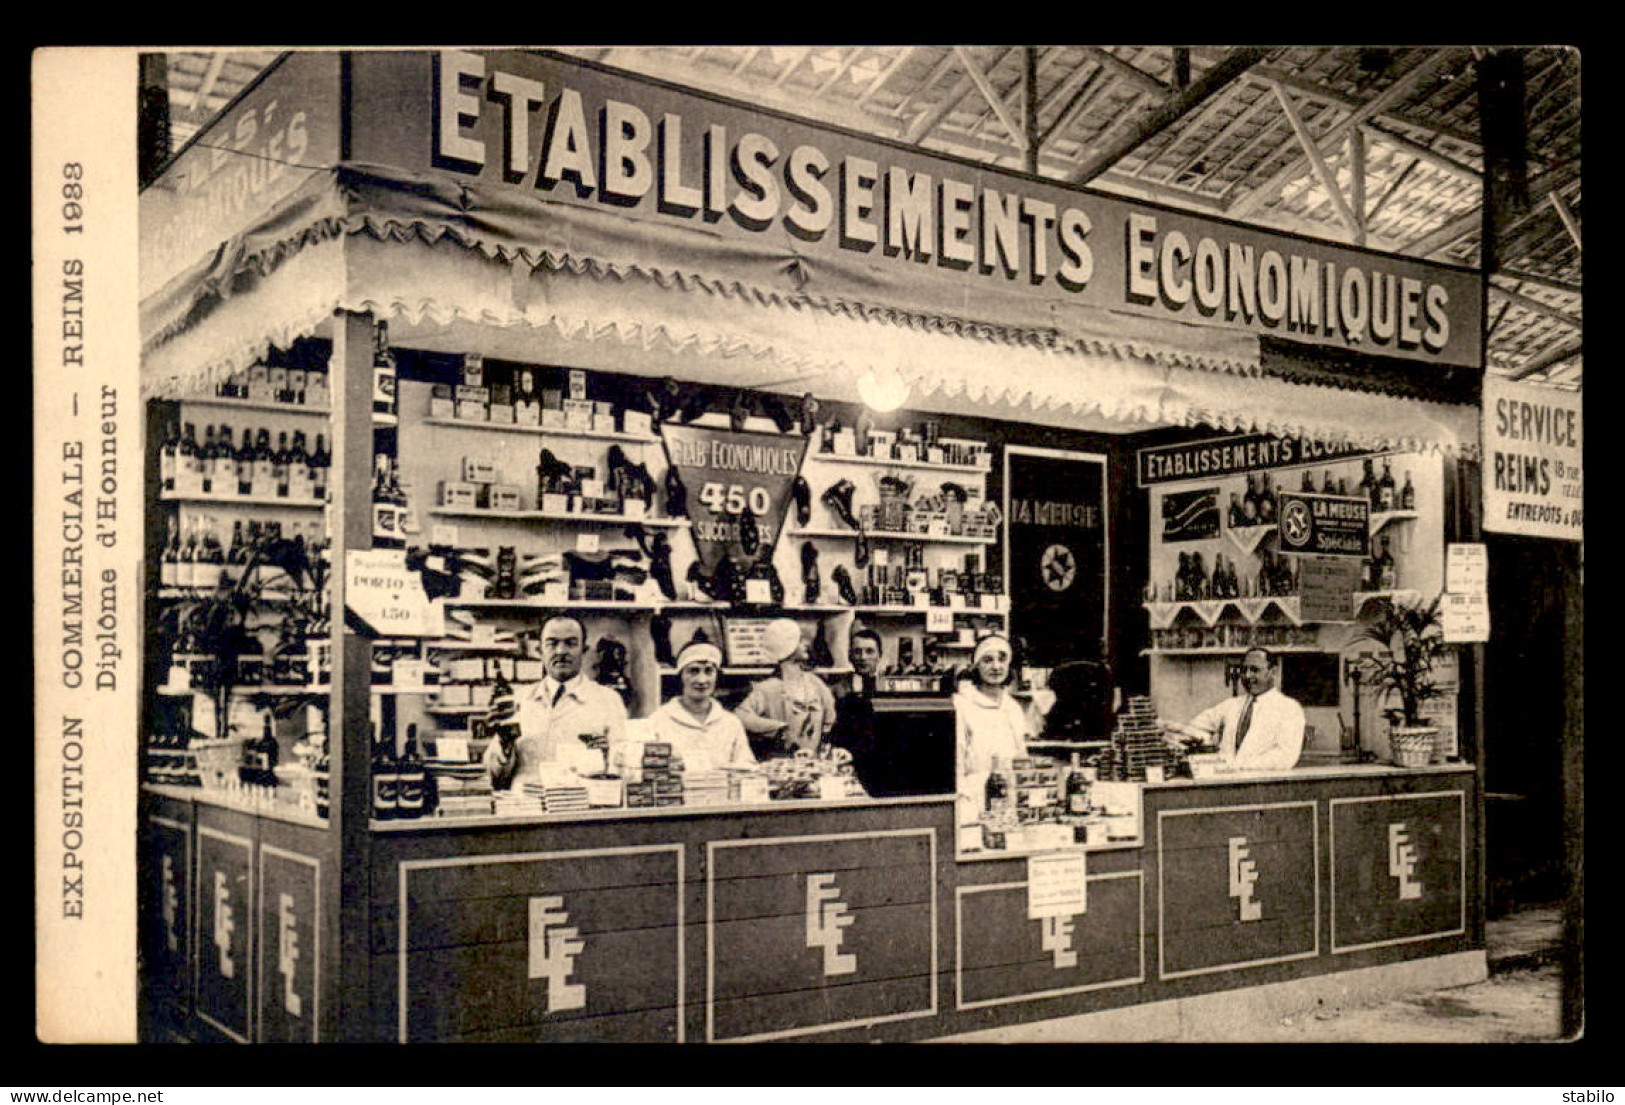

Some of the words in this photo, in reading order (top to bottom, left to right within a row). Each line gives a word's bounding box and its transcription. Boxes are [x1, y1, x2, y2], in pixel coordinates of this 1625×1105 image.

[432, 49, 1094, 293] ETABLISSEMENTS
[1125, 213, 1449, 354] ECONOMIQUES
[1497, 397, 1577, 448] SERVICE
[712, 440, 798, 475] ECONOMIQUES
[1147, 438, 1292, 478] ETABLISSEMENTS
[1494, 452, 1550, 496] REIMS
[700, 482, 771, 515] 450
[1328, 503, 1367, 519] MEUSE
